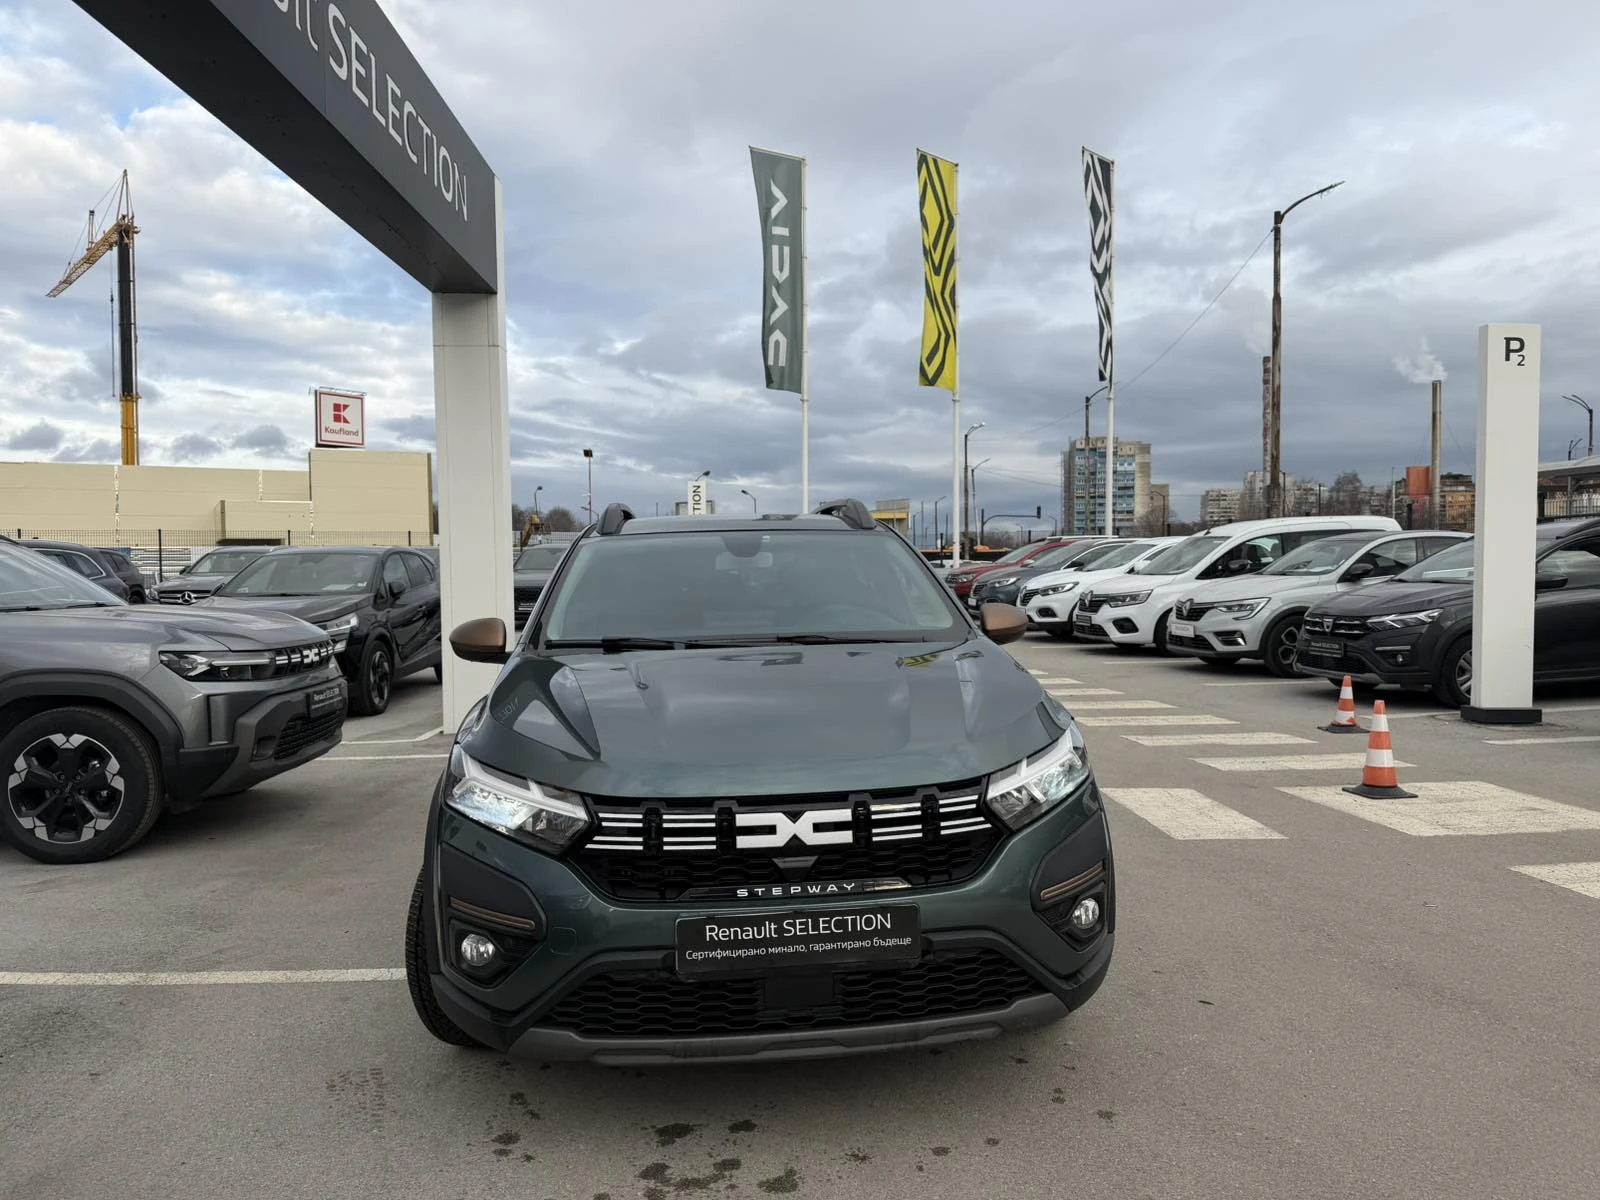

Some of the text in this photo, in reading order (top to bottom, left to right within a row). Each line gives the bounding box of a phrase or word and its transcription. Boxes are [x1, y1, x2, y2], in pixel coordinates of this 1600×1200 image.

[328, 3, 467, 221] SELECTION
[324, 425, 360, 437] Kaufland
[692, 485, 702, 515] TION
[736, 882, 855, 897] STEPWAY
[705, 913, 892, 942] Renault SELECTION
[685, 936, 912, 960] Сертифицирано минало, гарантирано бъдеще
